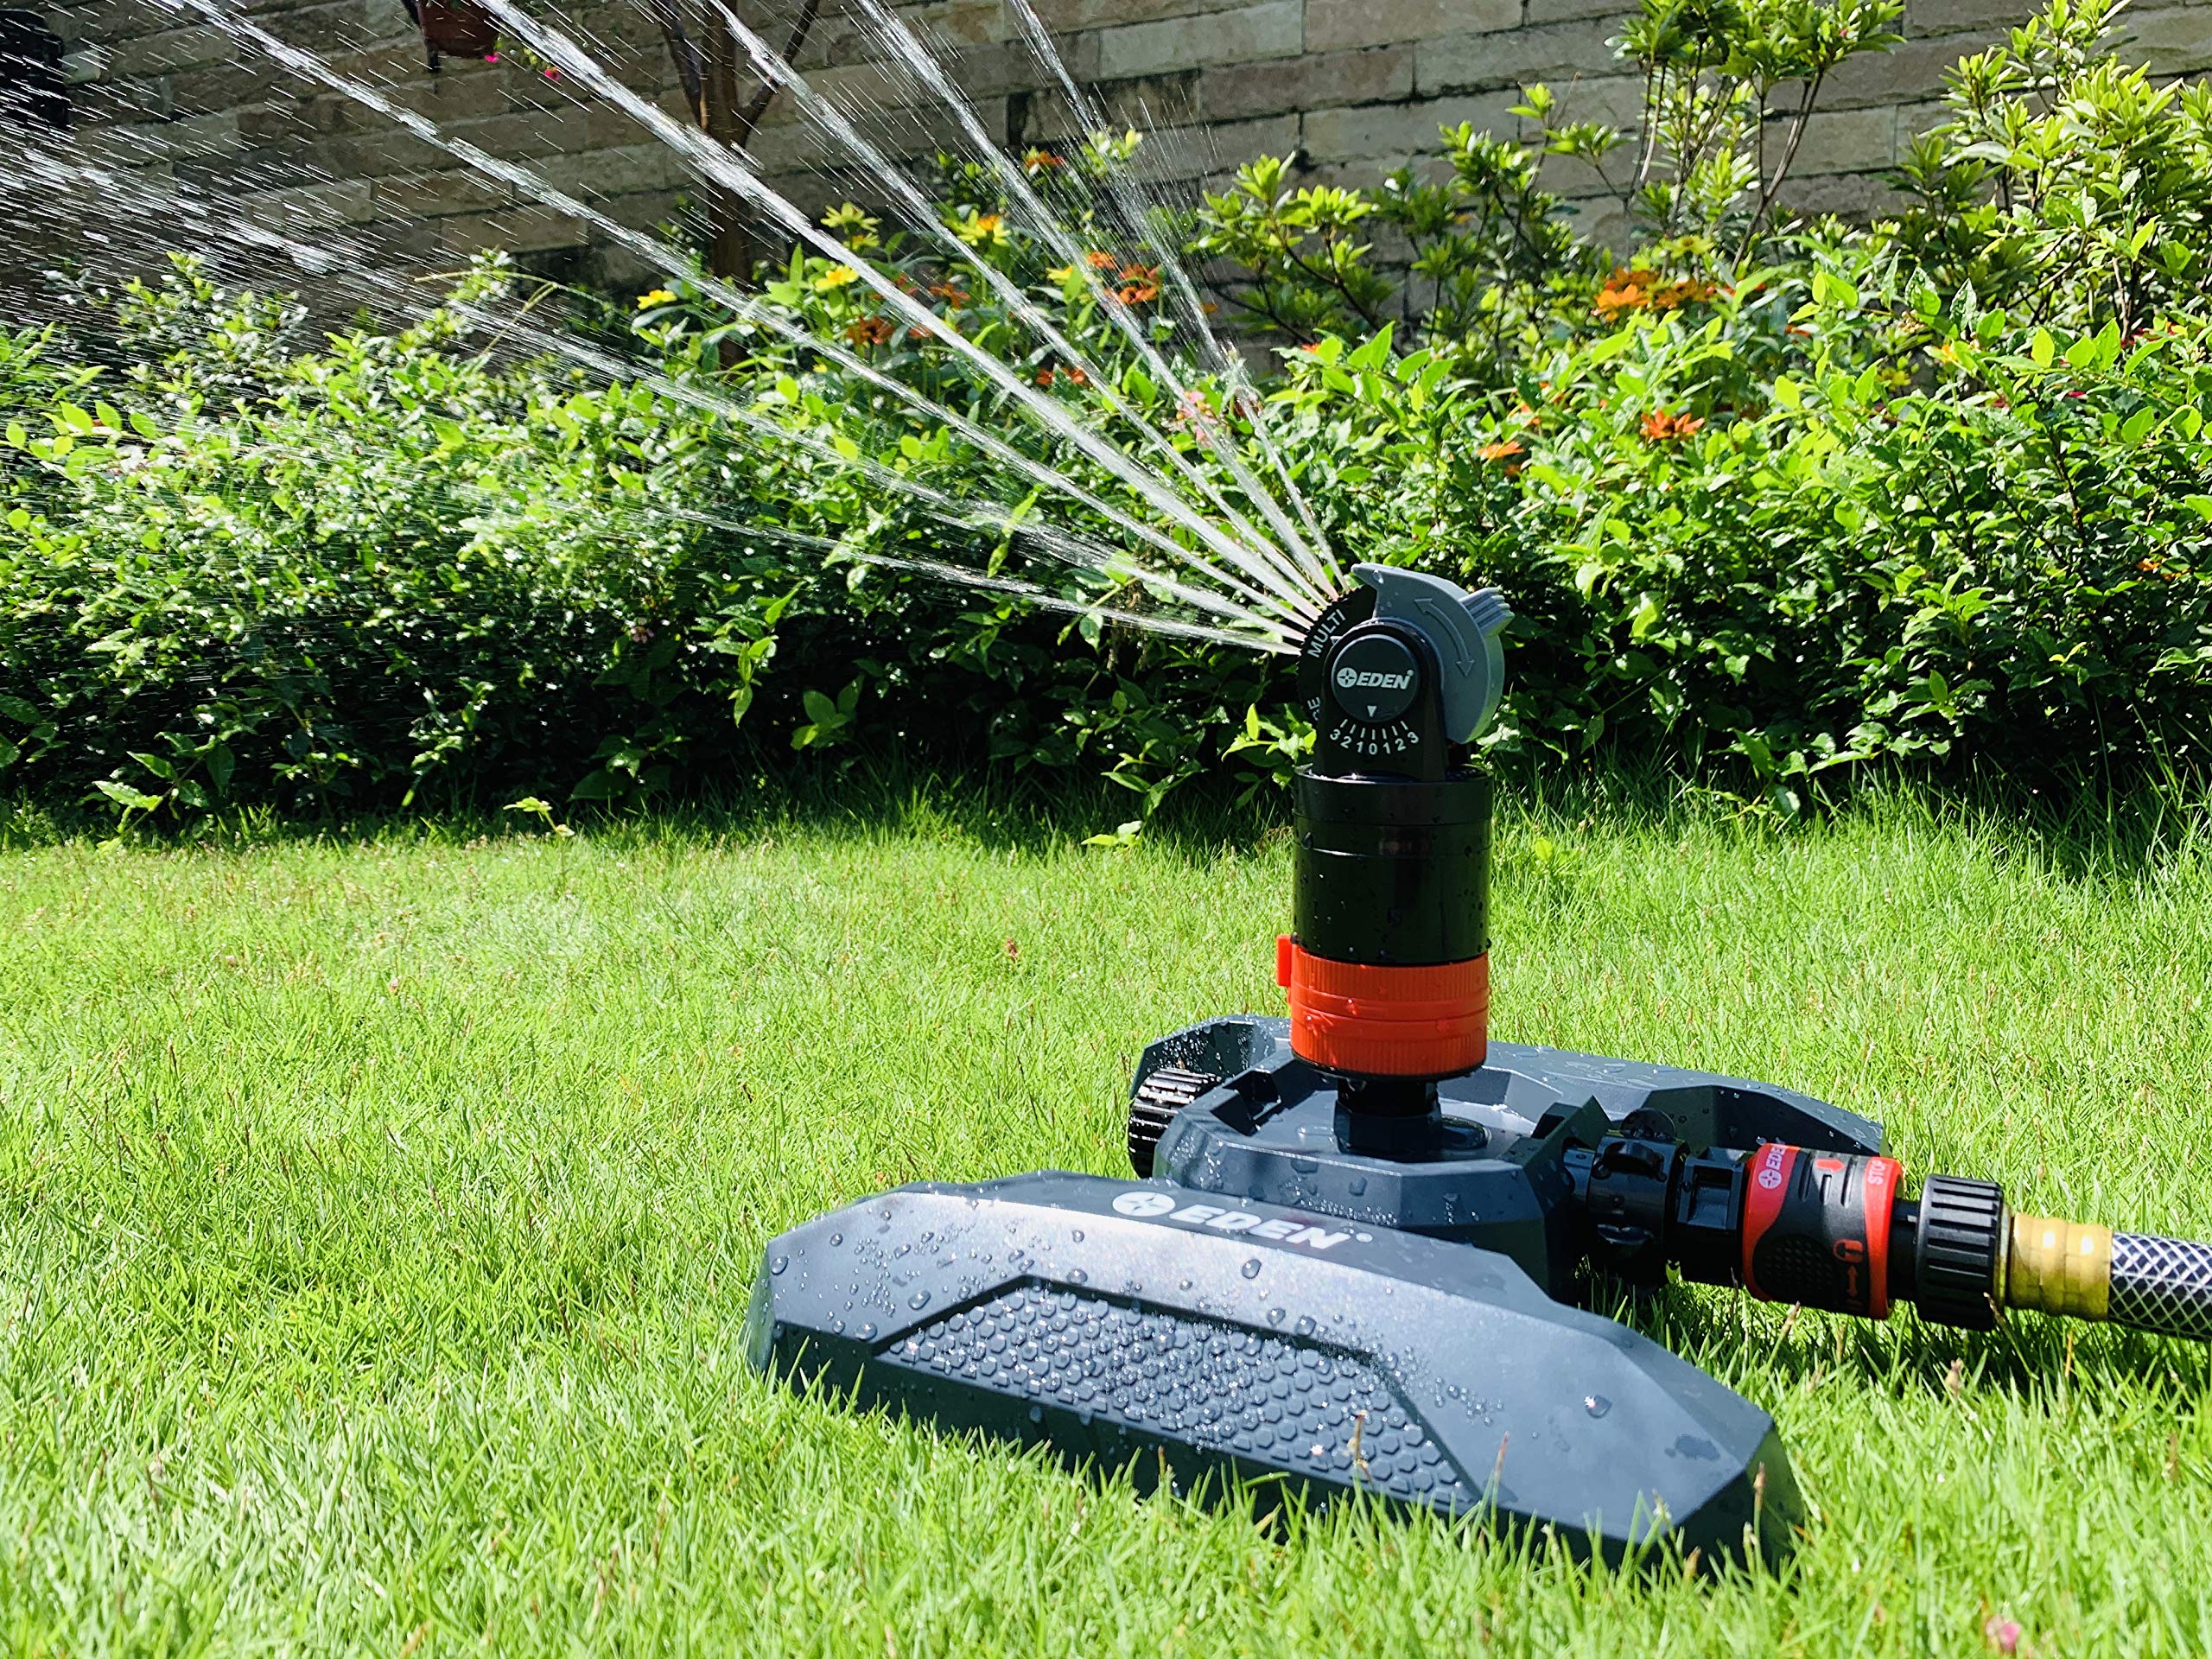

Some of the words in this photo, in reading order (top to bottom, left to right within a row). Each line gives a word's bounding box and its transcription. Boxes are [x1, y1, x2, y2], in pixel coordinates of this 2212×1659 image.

[1307, 608, 1345, 658] MULTI
[1356, 671, 1410, 690] EDEN
[1765, 1144, 1786, 1171] EDE
[1169, 1204, 1351, 1249] EDEN
